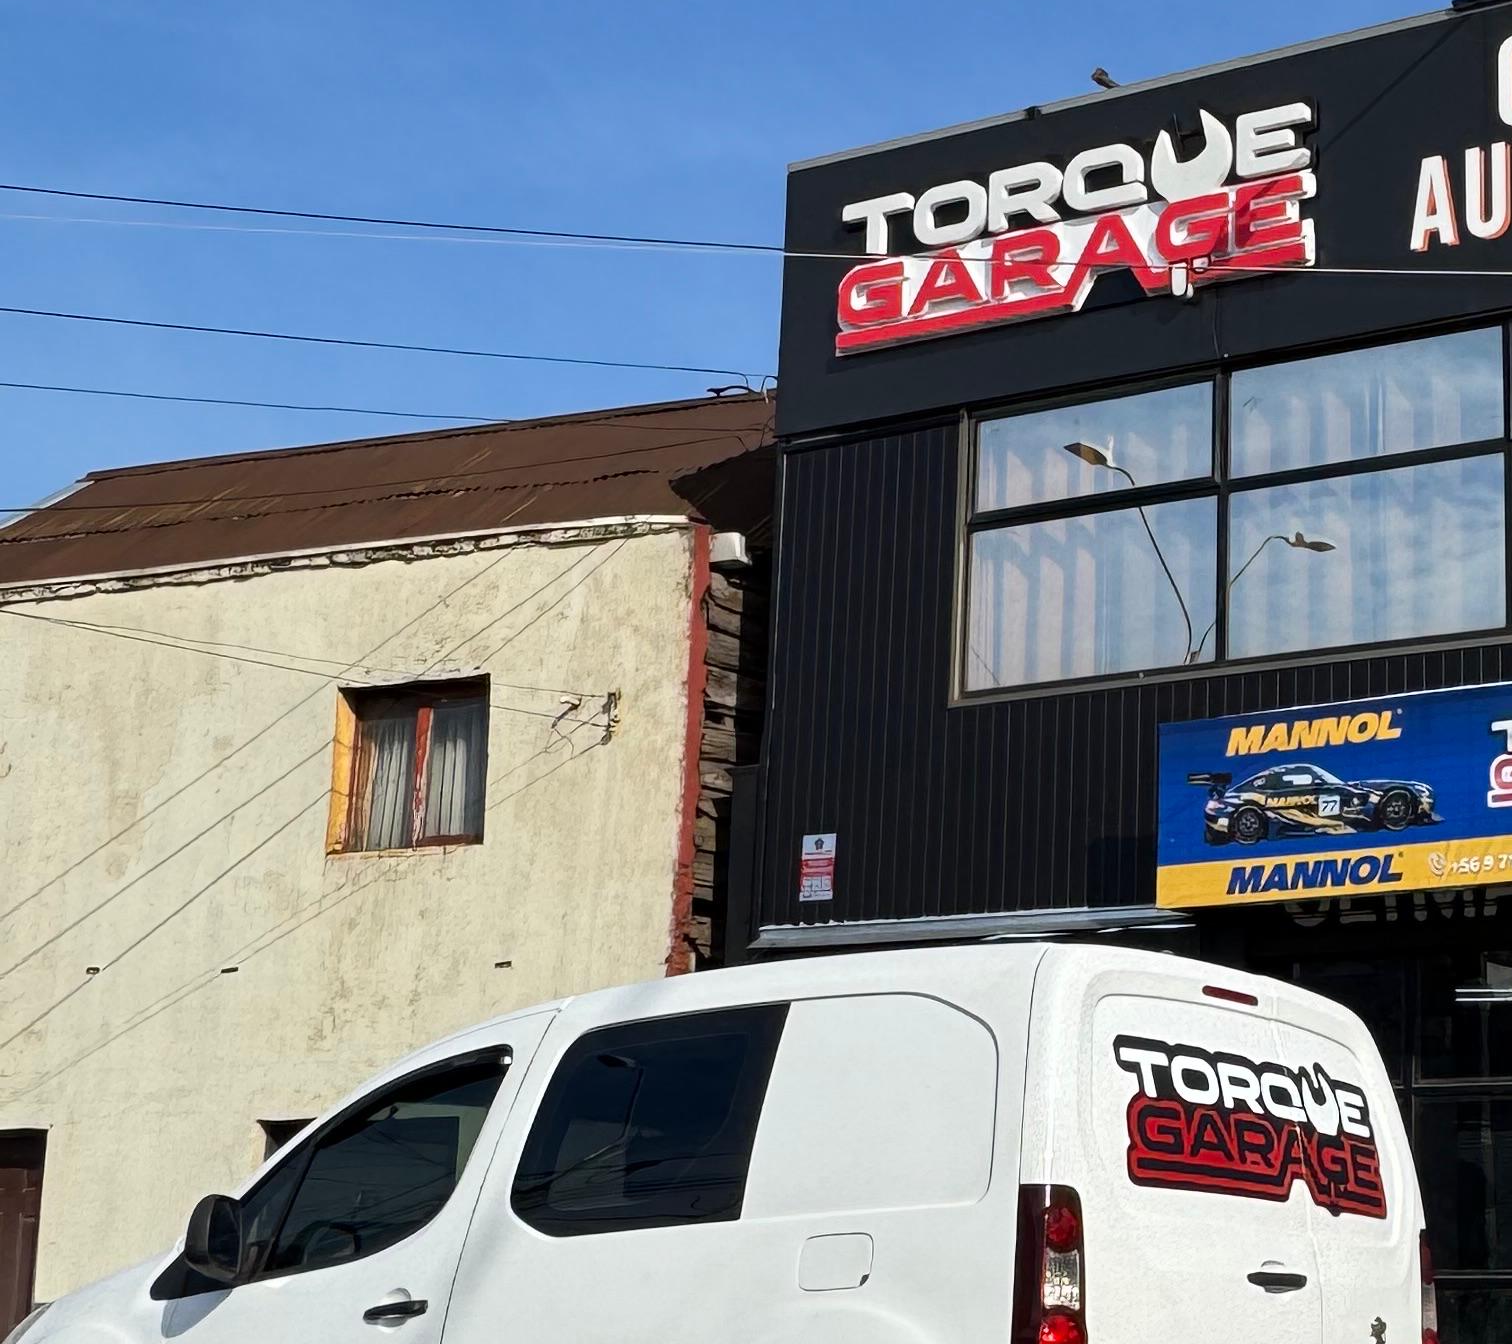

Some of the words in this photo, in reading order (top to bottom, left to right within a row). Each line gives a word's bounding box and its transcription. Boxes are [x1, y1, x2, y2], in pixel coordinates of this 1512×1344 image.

[842, 101, 1315, 256] TORQUE
[836, 171, 1317, 346] GARAGE
[1225, 709, 1402, 757] MANNOL
[1225, 853, 1403, 896] MANNOL
[1483, 854, 1495, 871] 9
[1119, 1046, 1371, 1139] TORQUE
[1136, 1105, 1384, 1196] GARAGE
